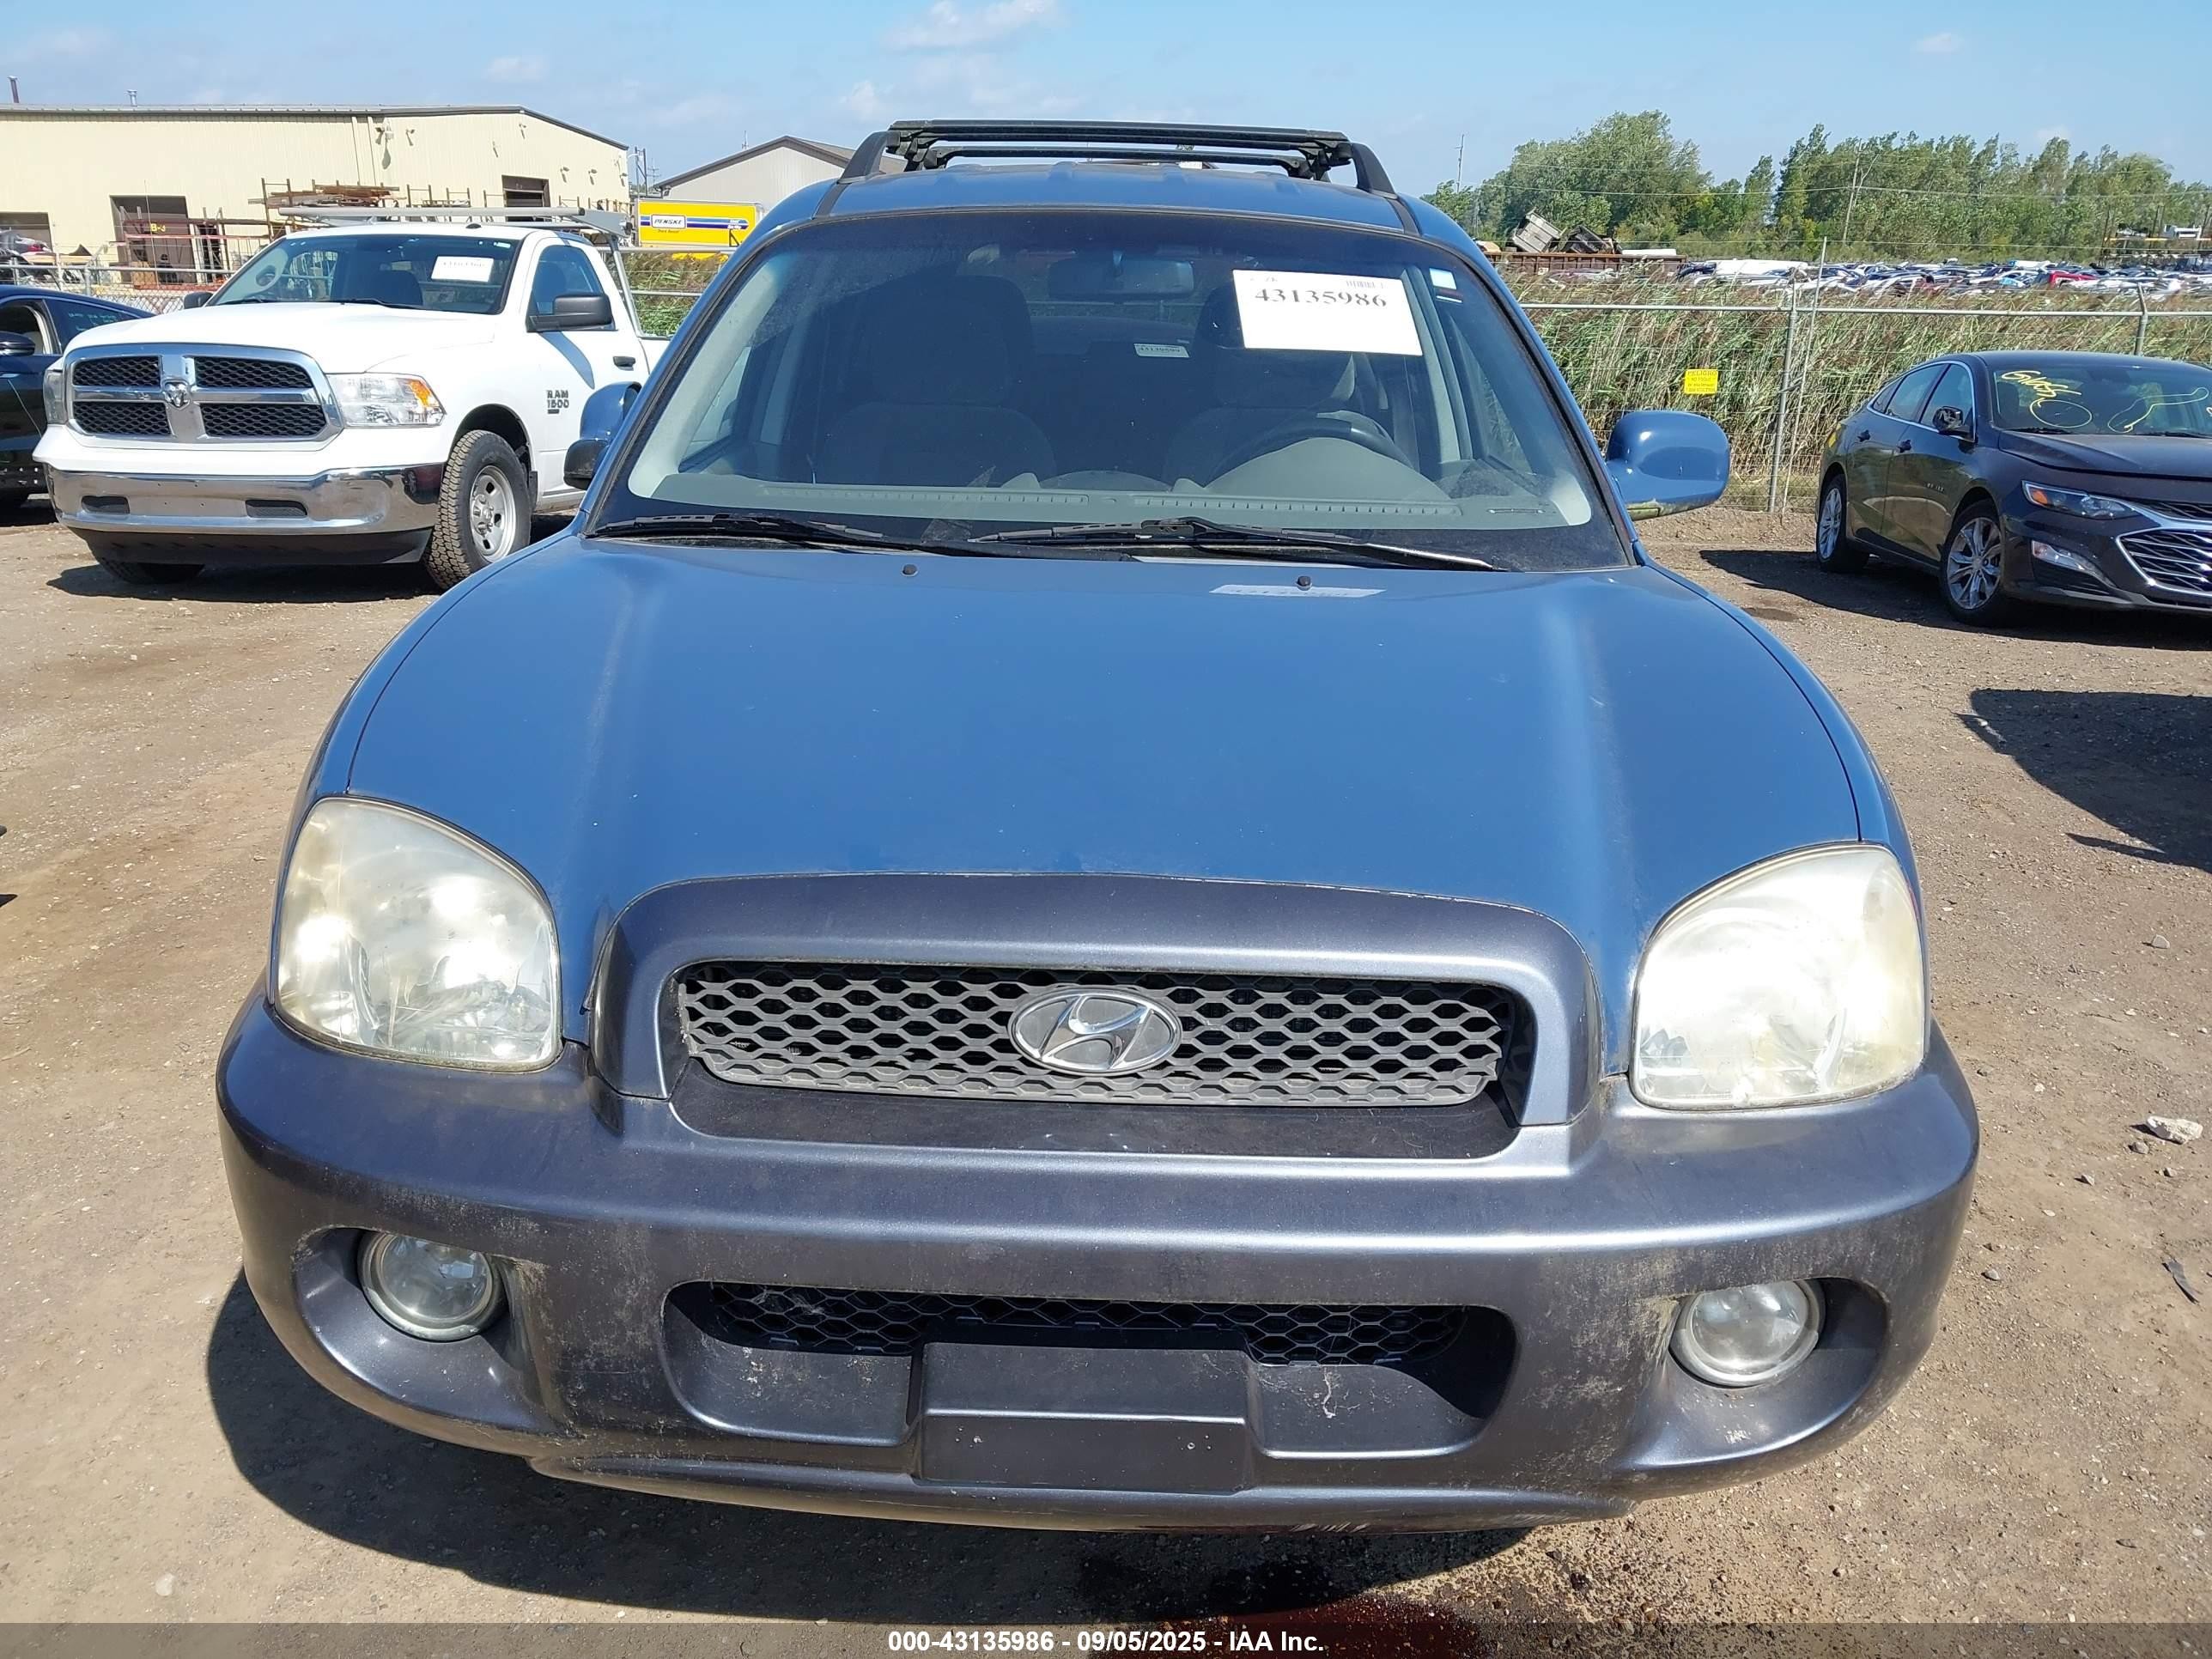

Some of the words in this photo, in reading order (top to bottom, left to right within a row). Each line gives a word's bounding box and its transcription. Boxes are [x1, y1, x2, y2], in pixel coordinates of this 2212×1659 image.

[1255, 289, 1387, 307] 43135986
[546, 389, 569, 399] RAM
[547, 398, 570, 409] 1500
